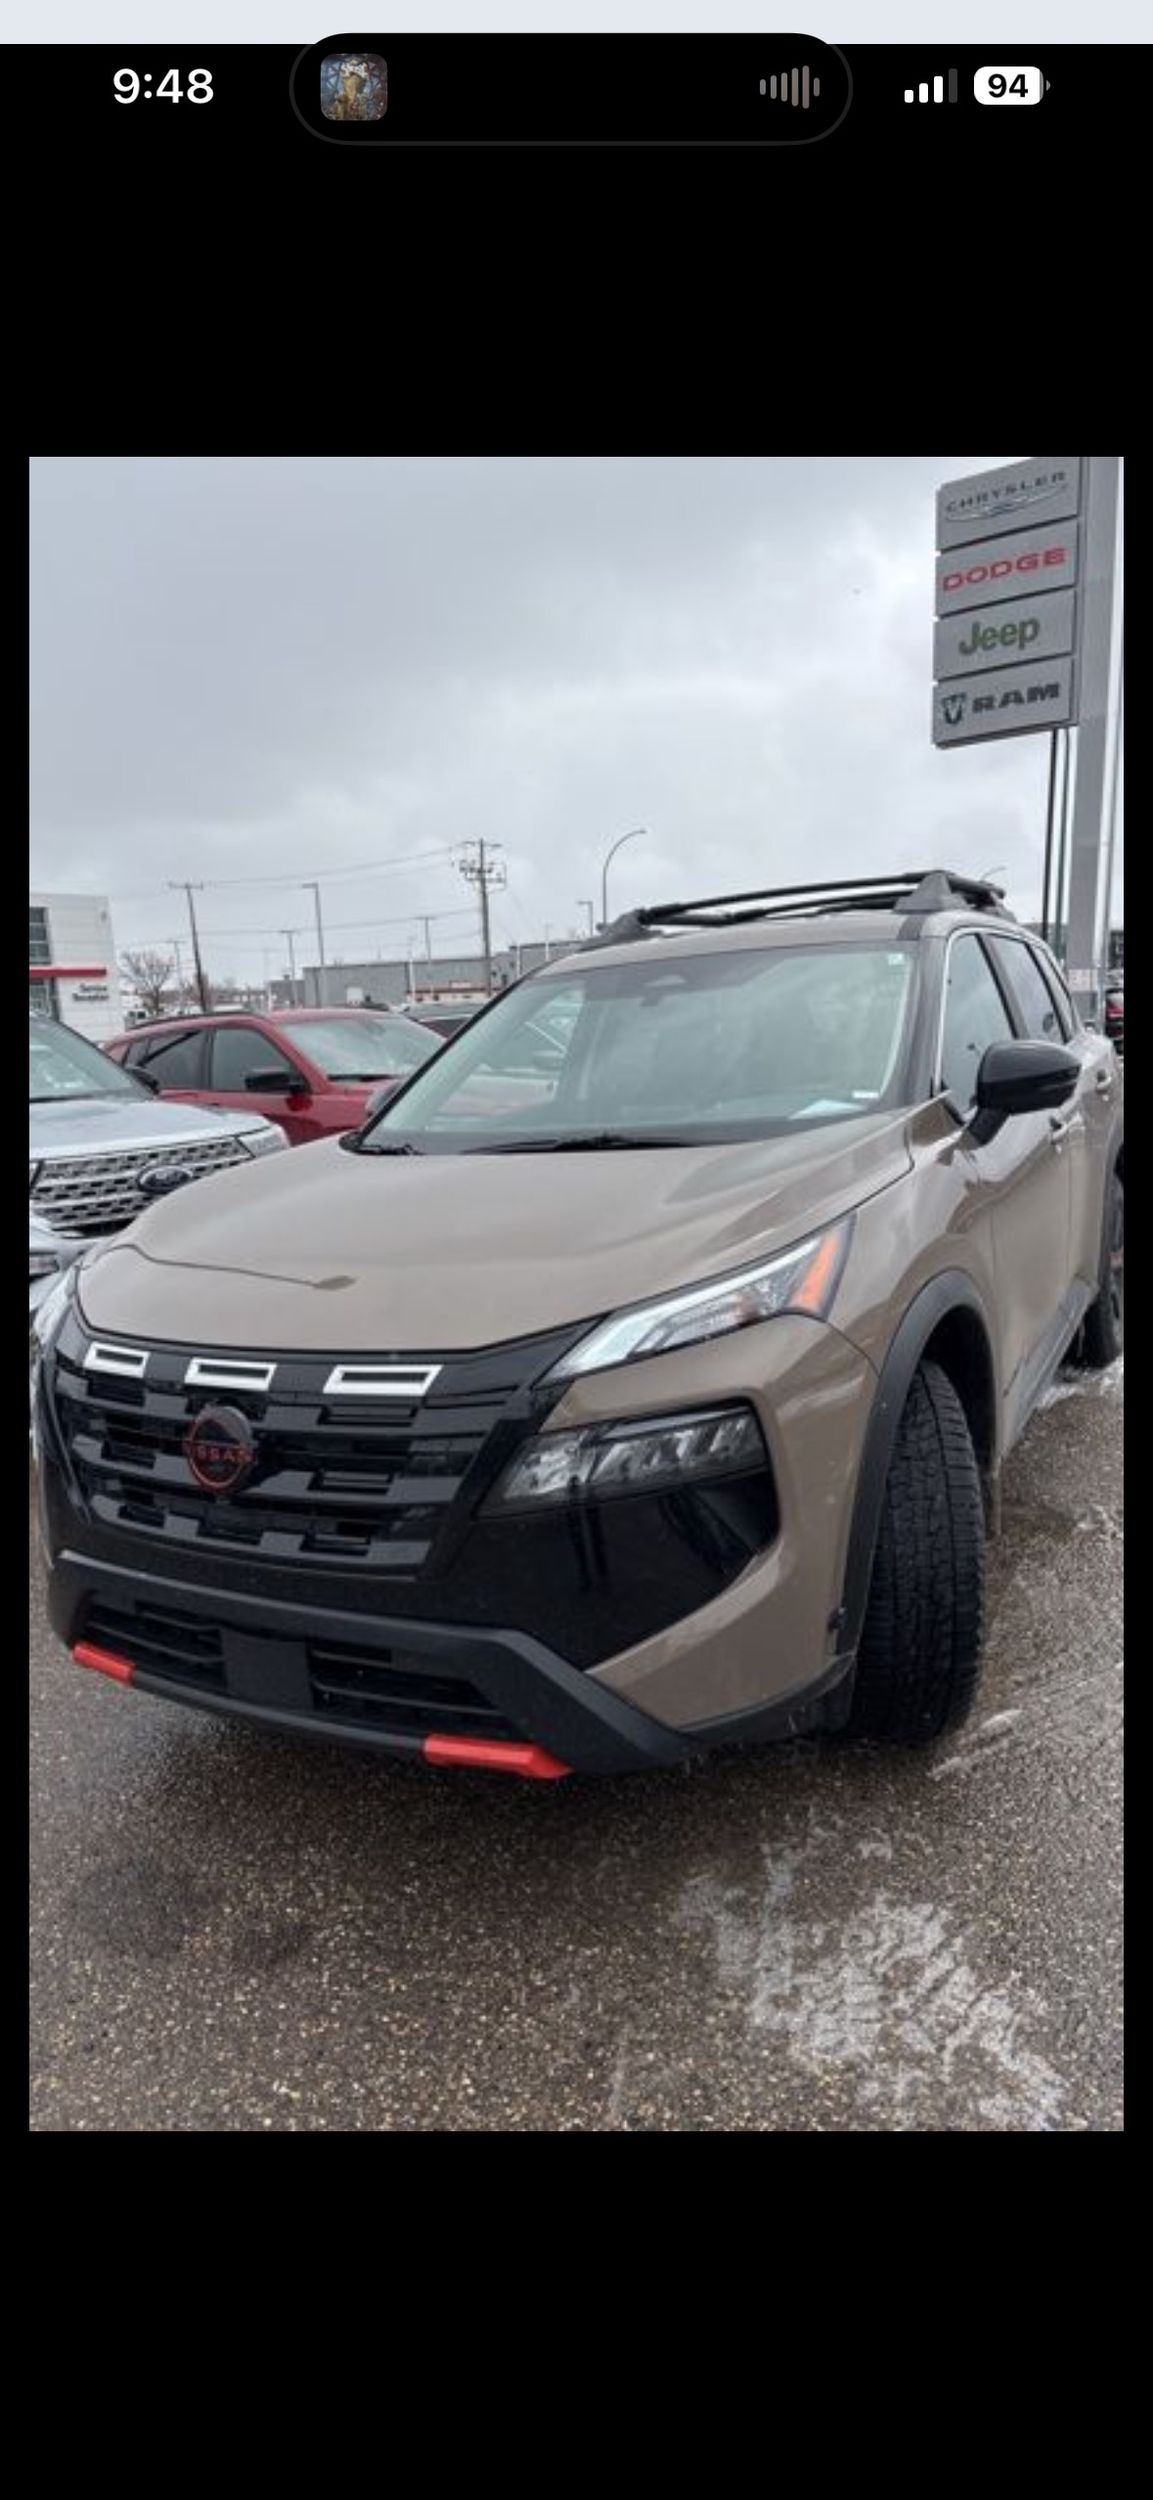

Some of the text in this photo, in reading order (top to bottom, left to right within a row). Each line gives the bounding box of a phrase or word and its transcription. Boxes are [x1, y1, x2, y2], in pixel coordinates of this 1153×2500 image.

[945, 472, 1065, 512] CHRYSLER
[942, 547, 1066, 591] DODGE
[959, 619, 1040, 655] Jeep
[972, 682, 1061, 714] RAM
